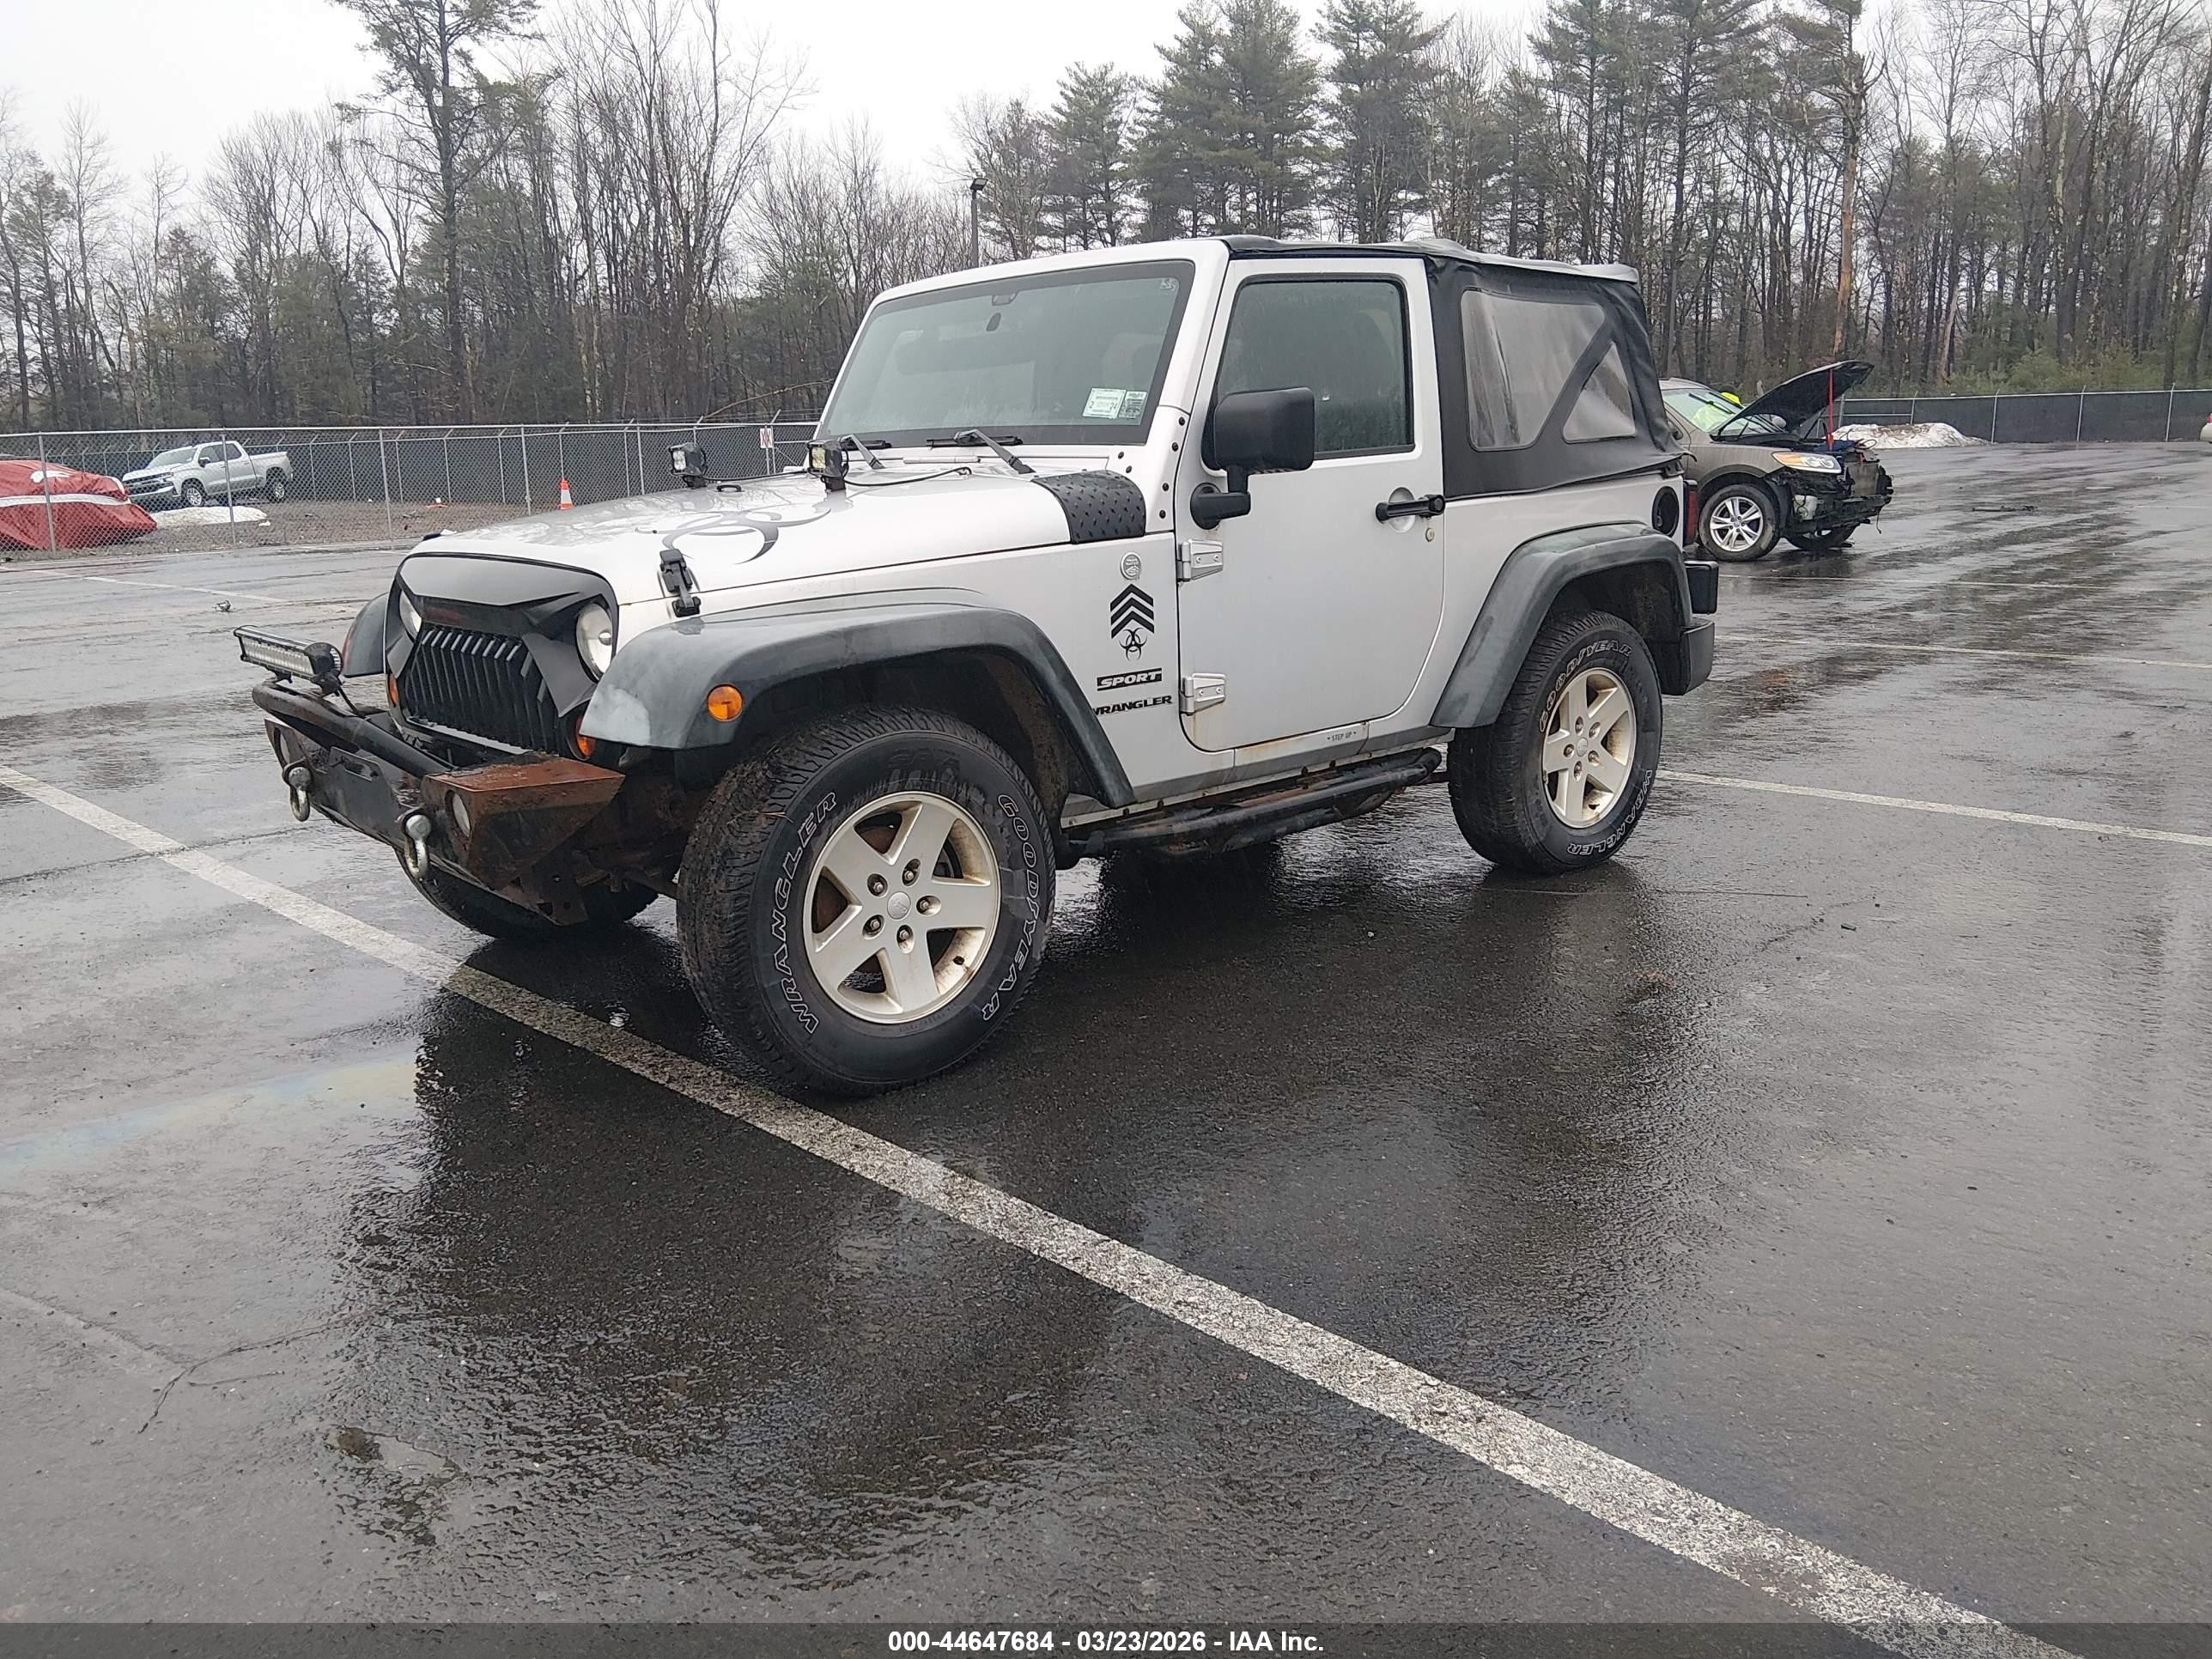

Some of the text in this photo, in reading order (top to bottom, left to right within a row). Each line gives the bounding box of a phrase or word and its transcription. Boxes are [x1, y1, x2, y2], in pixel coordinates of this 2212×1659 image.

[1098, 671, 1162, 688] SPORT
[1540, 640, 1632, 732] GOODYEAR
[773, 792, 837, 1034] WRANGLER
[981, 793, 1038, 1021] GOODYEAR
